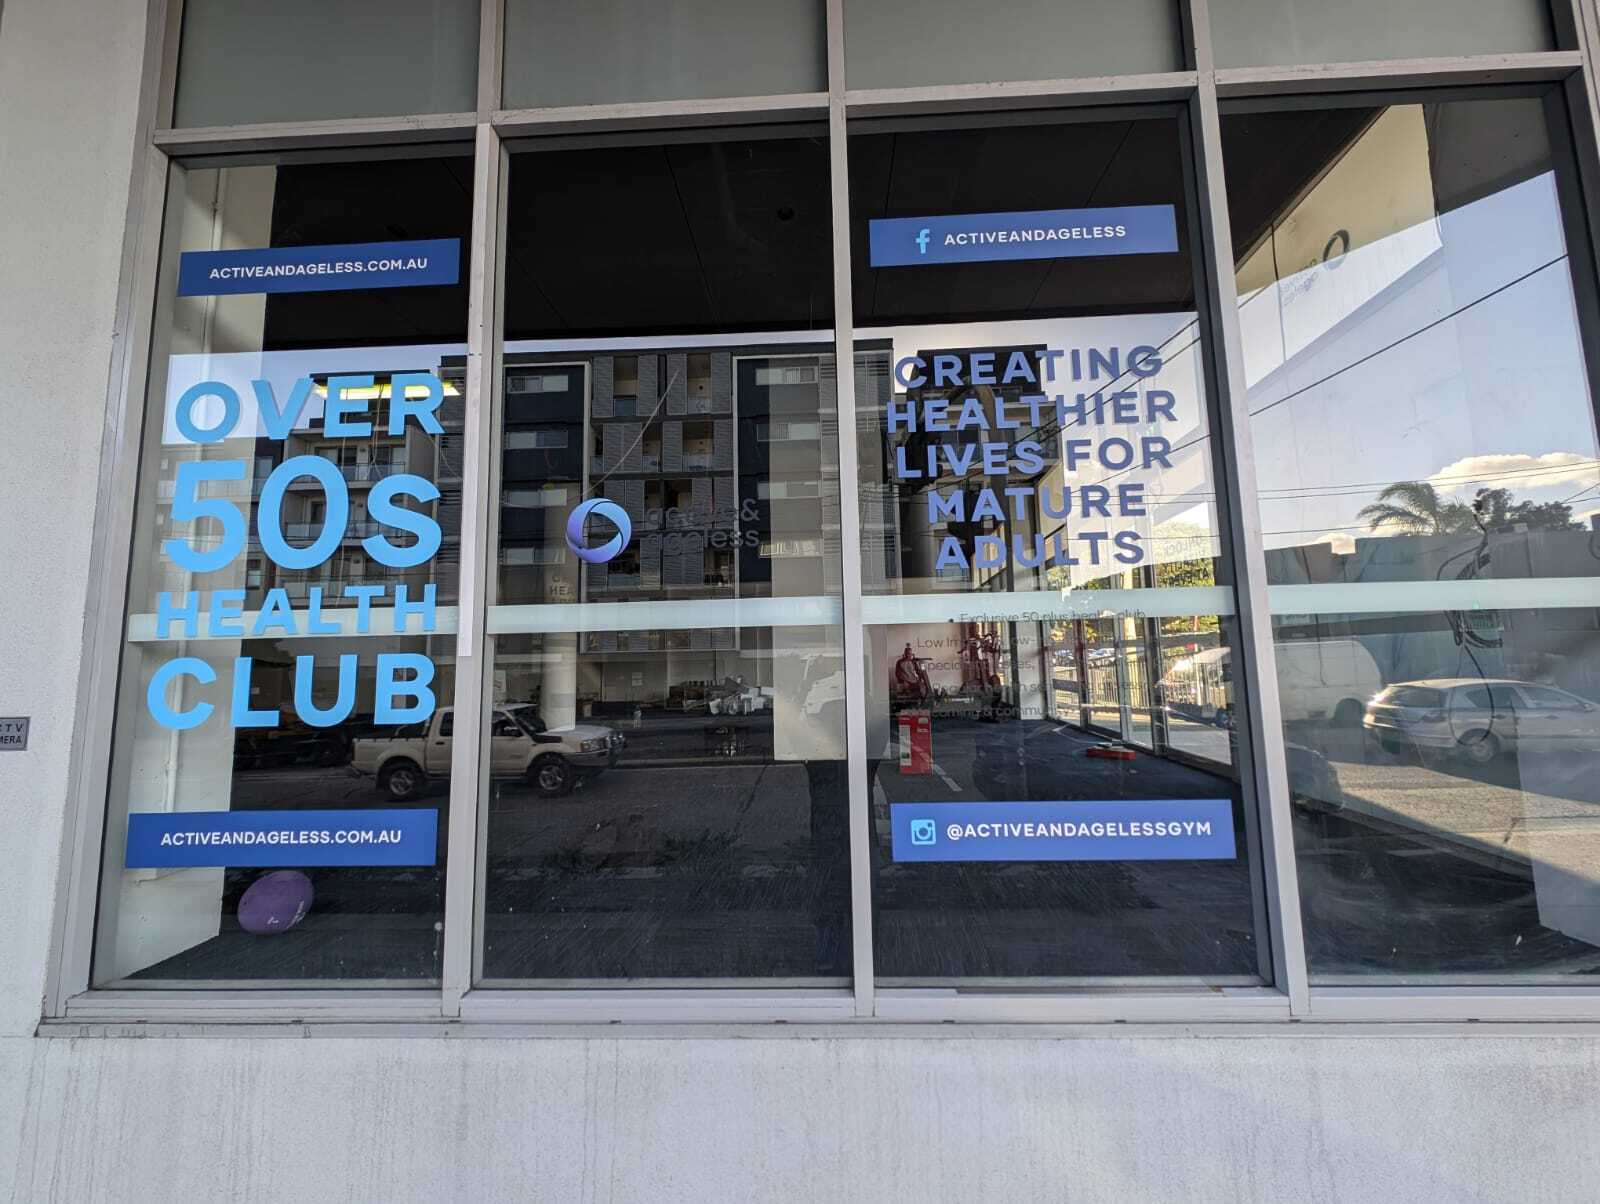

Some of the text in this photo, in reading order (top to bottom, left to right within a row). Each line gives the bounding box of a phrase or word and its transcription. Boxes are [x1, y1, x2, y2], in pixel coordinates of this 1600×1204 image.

[944, 225, 1127, 246] ACTIVEANDAGELESS
[209, 257, 428, 280] ACTIVEANDAGELESS.COM.AU
[894, 345, 1163, 389] CREATING
[175, 373, 446, 443] OVER
[886, 390, 1178, 434] HEALTHIER
[896, 436, 1174, 479] LIVES FOR
[740, 497, 761, 523] &
[928, 483, 1147, 524] MATURE
[935, 530, 1145, 570] ADULTS
[156, 584, 437, 639] HEALTH
[916, 637, 943, 649] Low
[146, 653, 436, 730] CLUB
[0, 723, 24, 732] TV
[160, 829, 402, 846] ACTIVEANDAGELESS.COM.AU
[946, 821, 1212, 841] @ACTIVEANDAGELESSGYM
